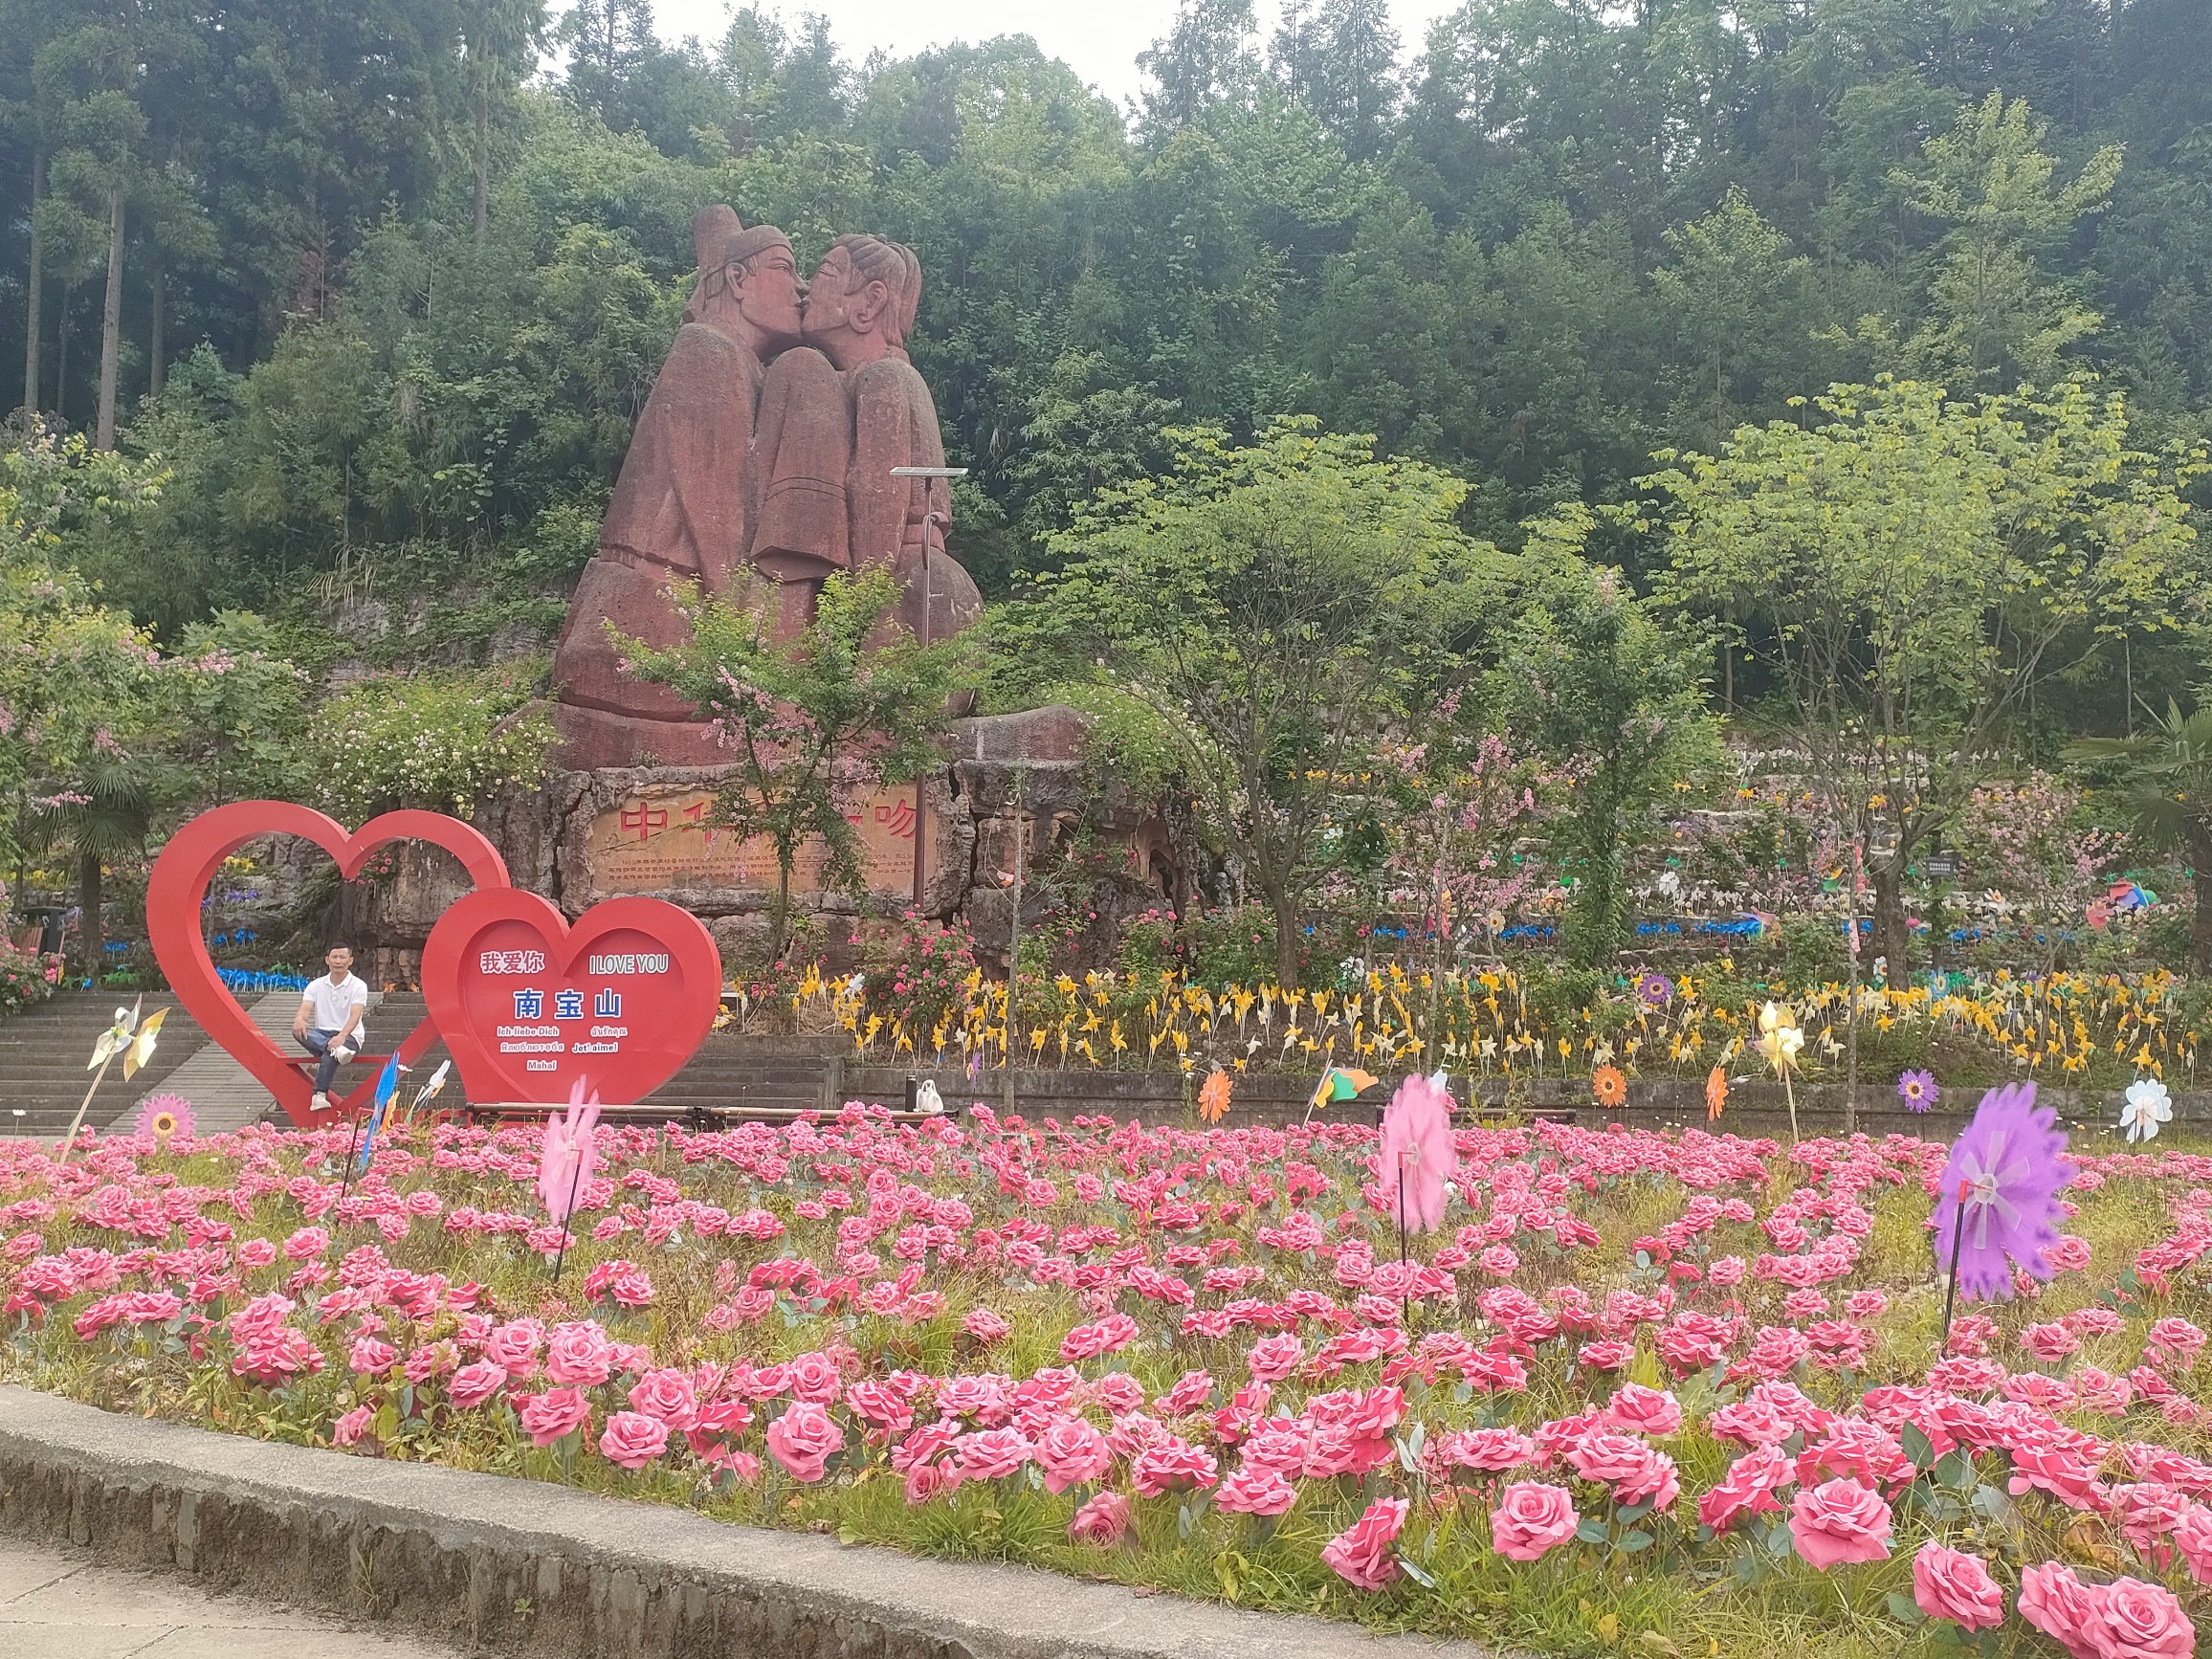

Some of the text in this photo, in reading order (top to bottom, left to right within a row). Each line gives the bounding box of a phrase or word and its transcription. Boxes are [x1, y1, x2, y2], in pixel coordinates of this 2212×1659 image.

[481, 951, 545, 974] 我爱你
[589, 954, 669, 974] I LOVE YOU
[514, 988, 622, 1019] 南宝山
[498, 1027, 560, 1037] Ich liebe Dich
[527, 1060, 558, 1072] Mahal
